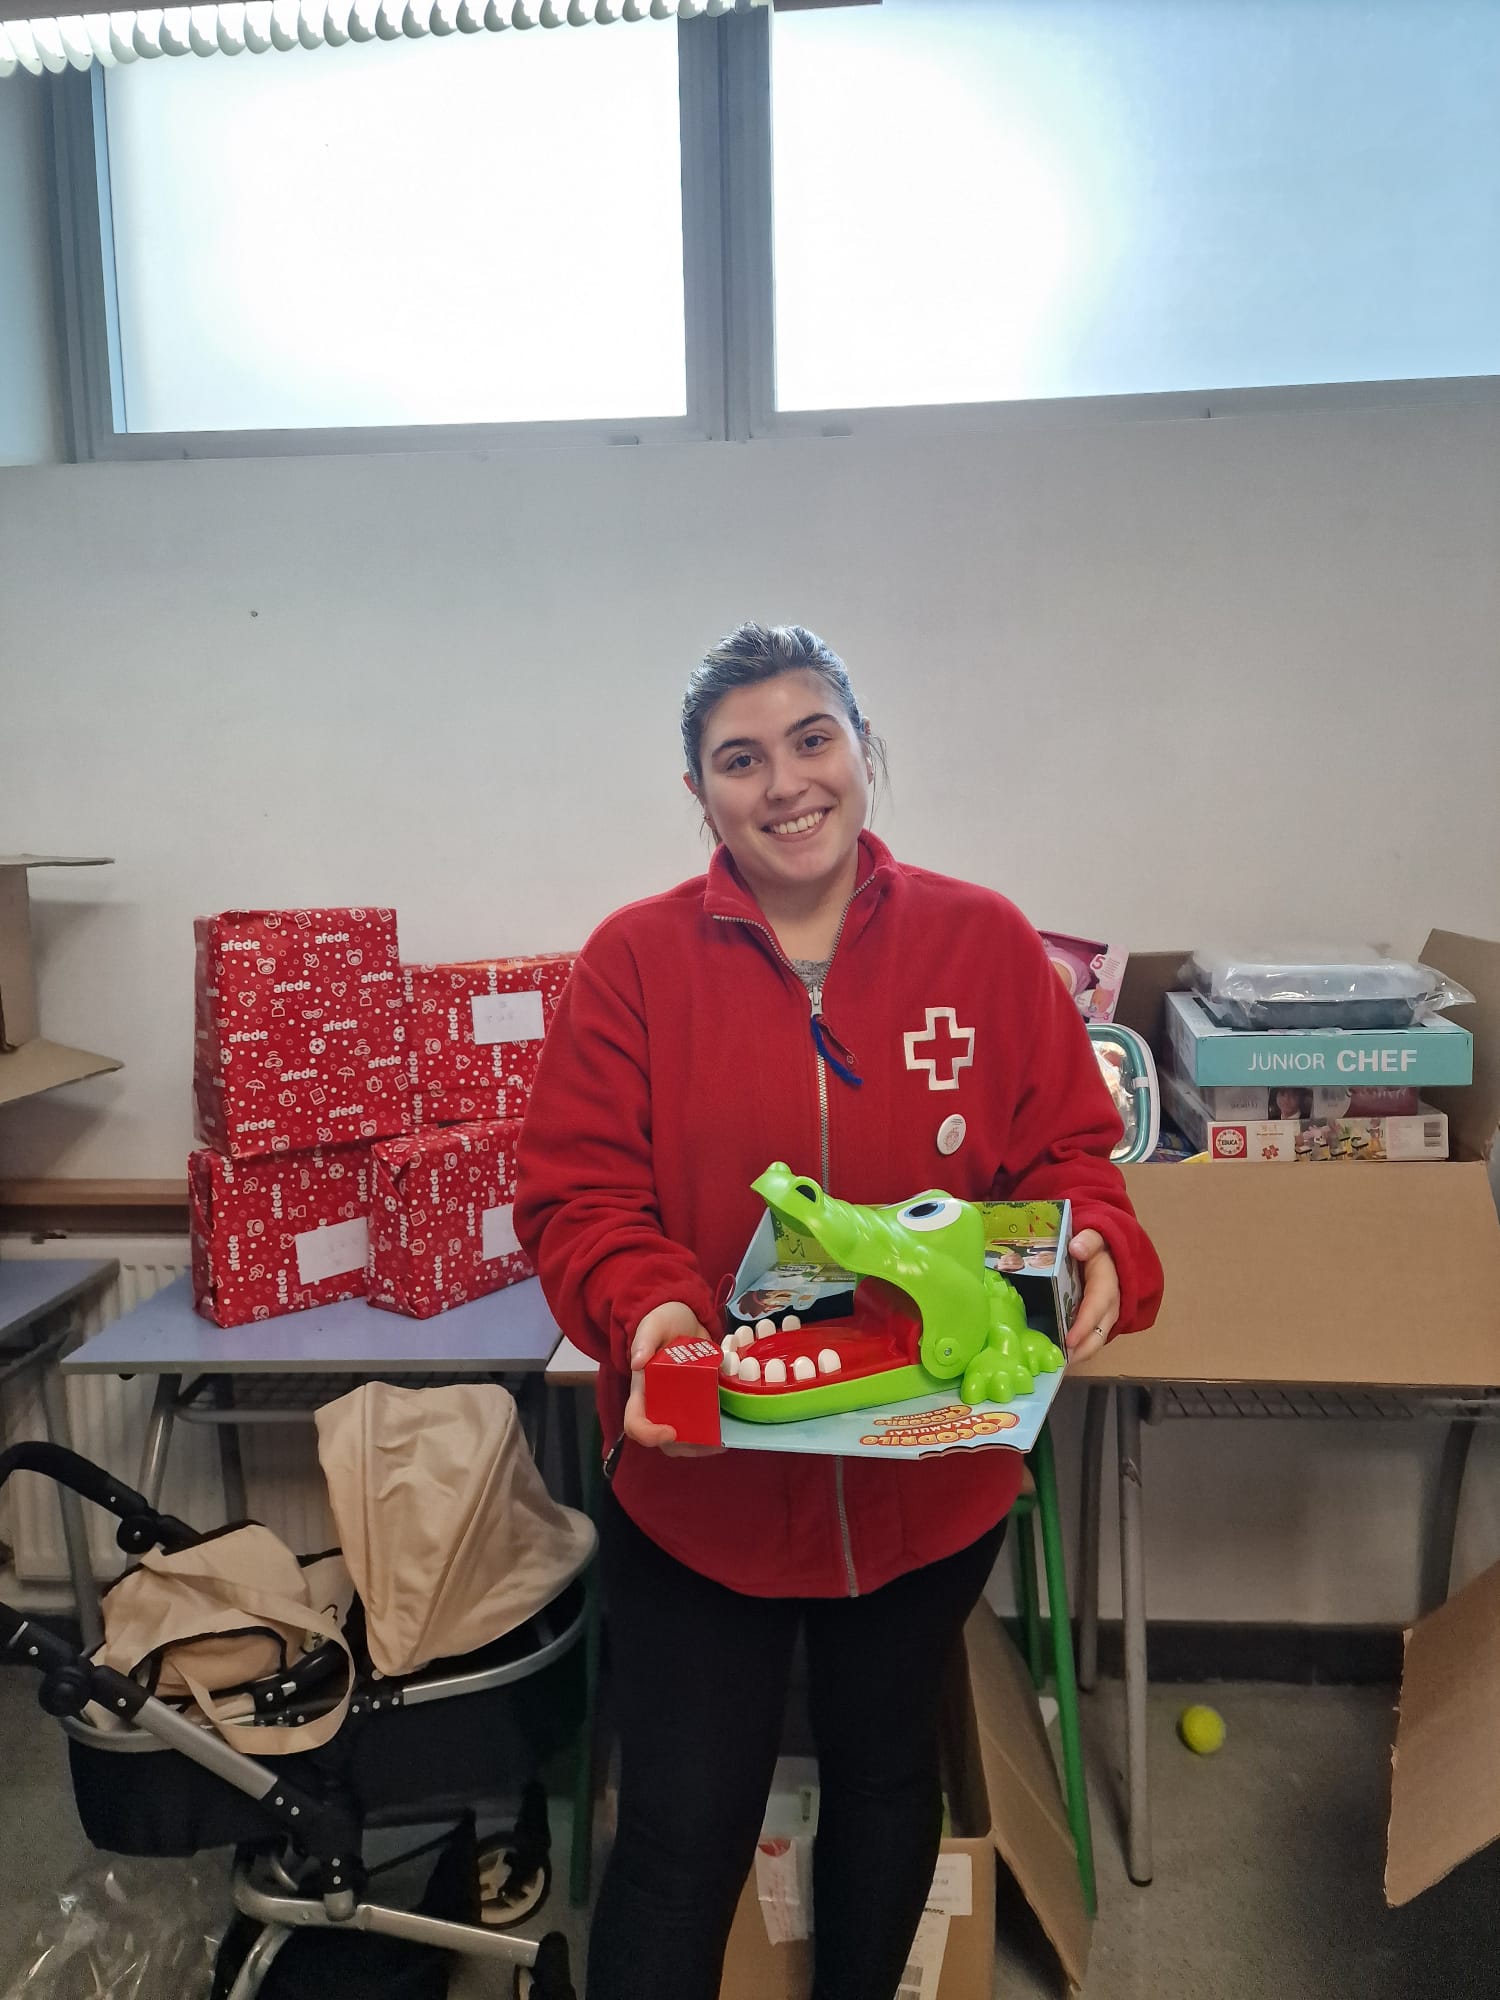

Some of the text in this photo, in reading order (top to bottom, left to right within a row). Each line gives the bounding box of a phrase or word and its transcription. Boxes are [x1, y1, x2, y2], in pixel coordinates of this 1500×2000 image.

[221, 940, 260, 951] afede
[315, 932, 350, 944] afede
[361, 970, 393, 983] afede
[1092, 956, 1105, 969] 5
[274, 980, 311, 993] afede
[403, 968, 414, 1003] afede
[229, 1030, 268, 1043] afede
[323, 1019, 357, 1032] afede
[448, 1007, 458, 1040] afede
[280, 1068, 317, 1081] afede
[368, 1056, 401, 1068] afede
[407, 1050, 419, 1085] afede
[492, 1045, 503, 1078] afede
[1248, 1049, 1417, 1072] JUNIOR CHEF
[329, 1104, 363, 1117] afede
[236, 1119, 276, 1132] afede
[497, 1152, 505, 1186] afede
[356, 1168, 367, 1203] afede
[430, 1168, 439, 1204] afede
[270, 1183, 283, 1219] afede
[400, 1214, 409, 1248] afede
[466, 1202, 475, 1237] afede
[227, 1235, 240, 1271] afede
[276, 1269, 288, 1305] afede
[434, 1255, 443, 1291] afede
[861, 1412, 1019, 1446] COCODRILO
[874, 1405, 972, 1426] CROCODILO
[889, 1416, 983, 1435] SACAMUELAS
